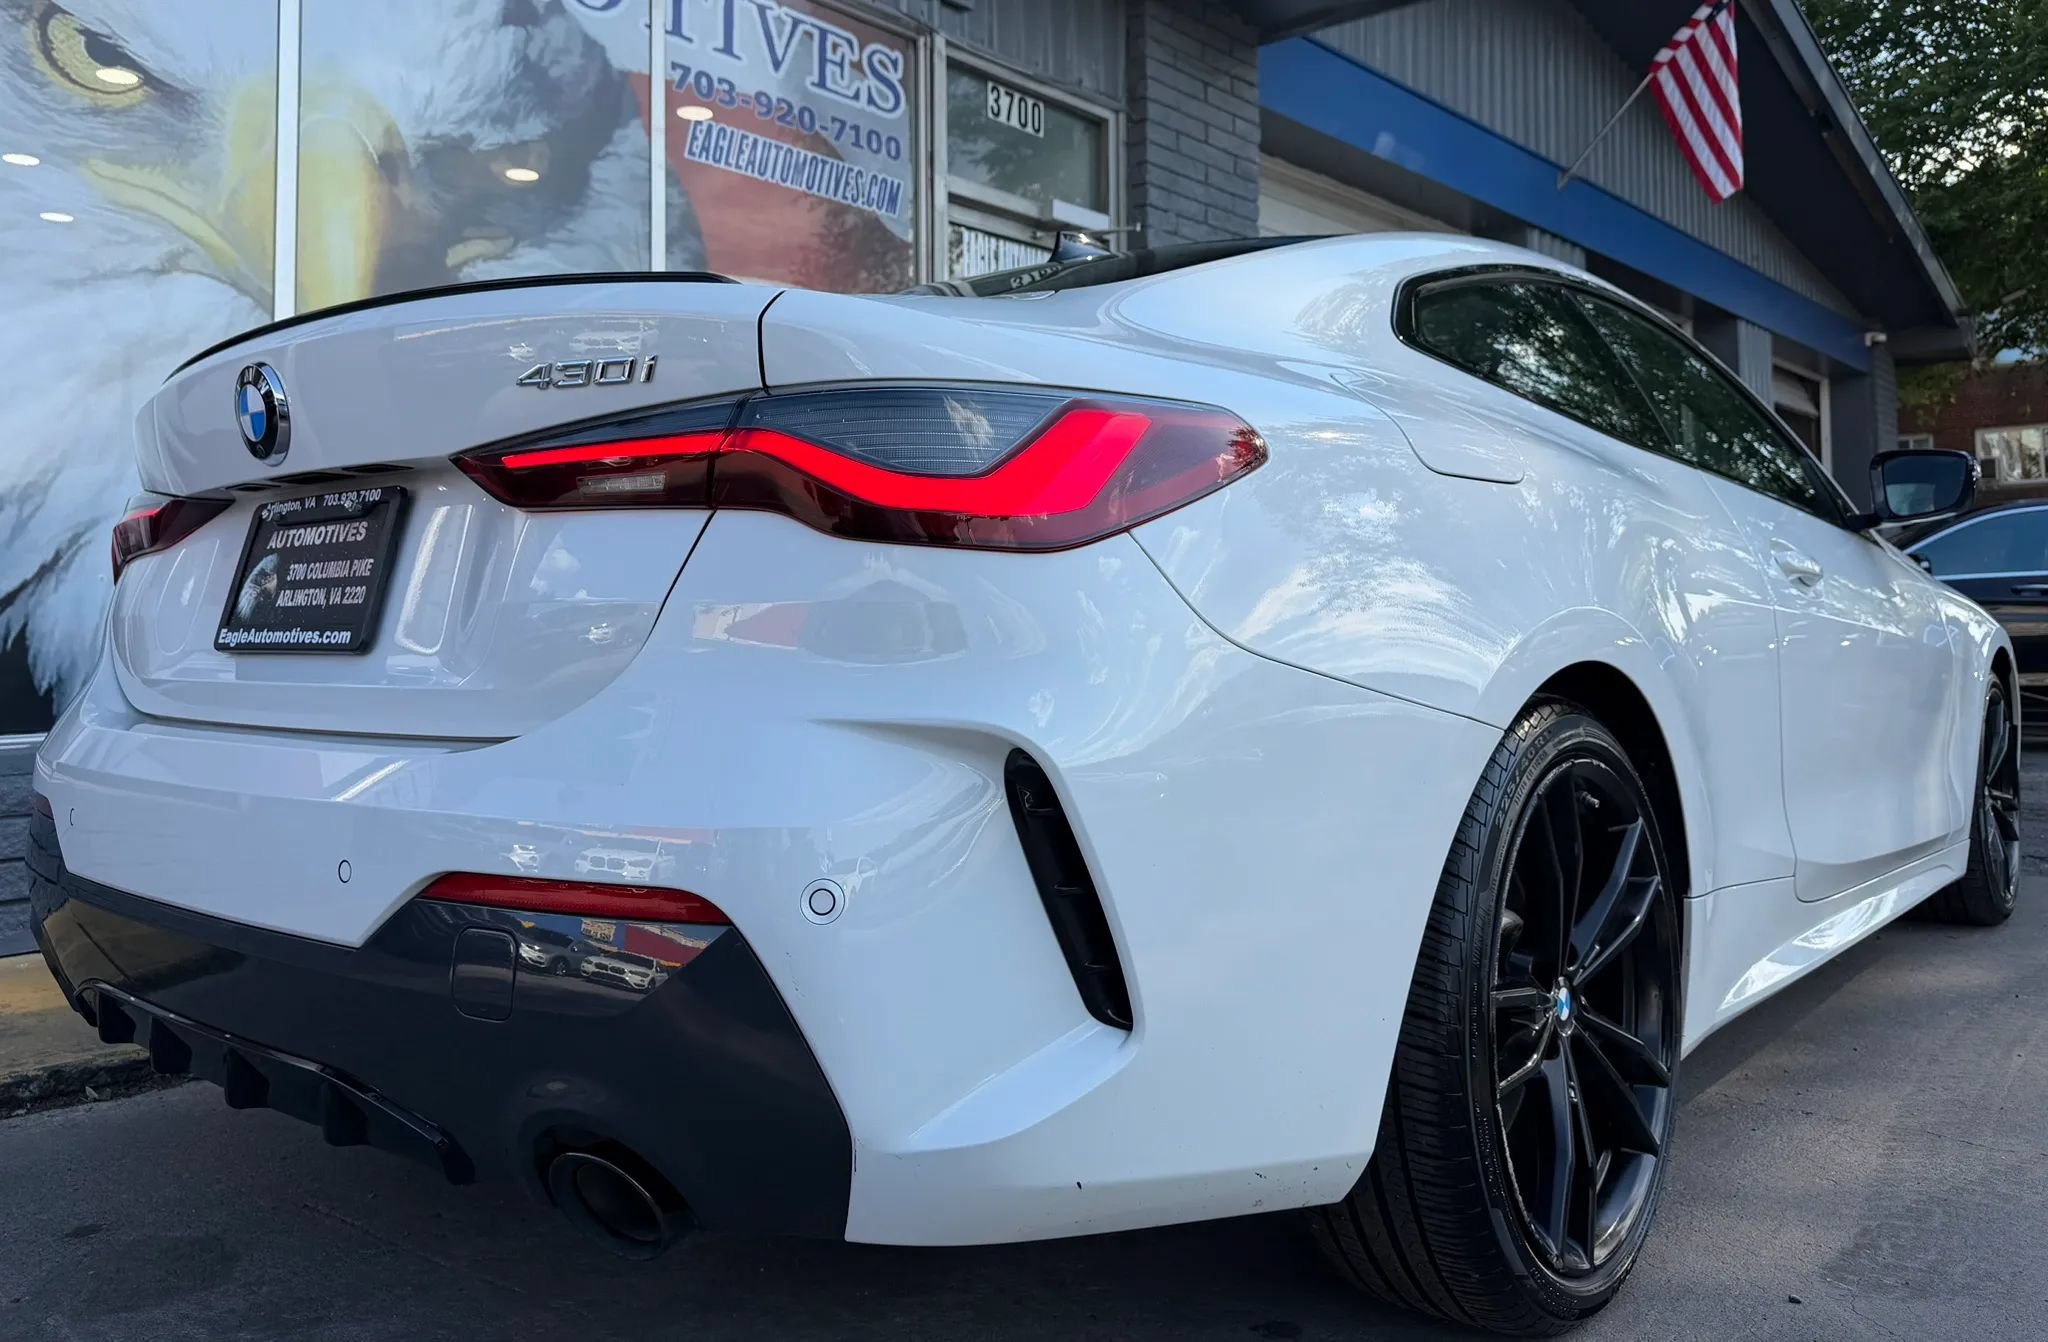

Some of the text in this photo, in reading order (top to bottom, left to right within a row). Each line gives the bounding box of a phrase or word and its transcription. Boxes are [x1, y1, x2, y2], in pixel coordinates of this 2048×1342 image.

[575, 0, 903, 114] IVES
[670, 62, 901, 161] 703-920-7100
[990, 86, 1041, 134] 3700
[686, 121, 901, 216] EAGLEAUTOMOTIVES.COM
[516, 354, 657, 390] 430i
[305, 497, 316, 509] VA
[266, 521, 368, 550] AUTOMOTIVES
[287, 558, 374, 581] 3700 COLUMBIA PIKE
[275, 585, 366, 609] ARLINGTON, VA 2220
[218, 627, 352, 647] EagleAutomotives.com
